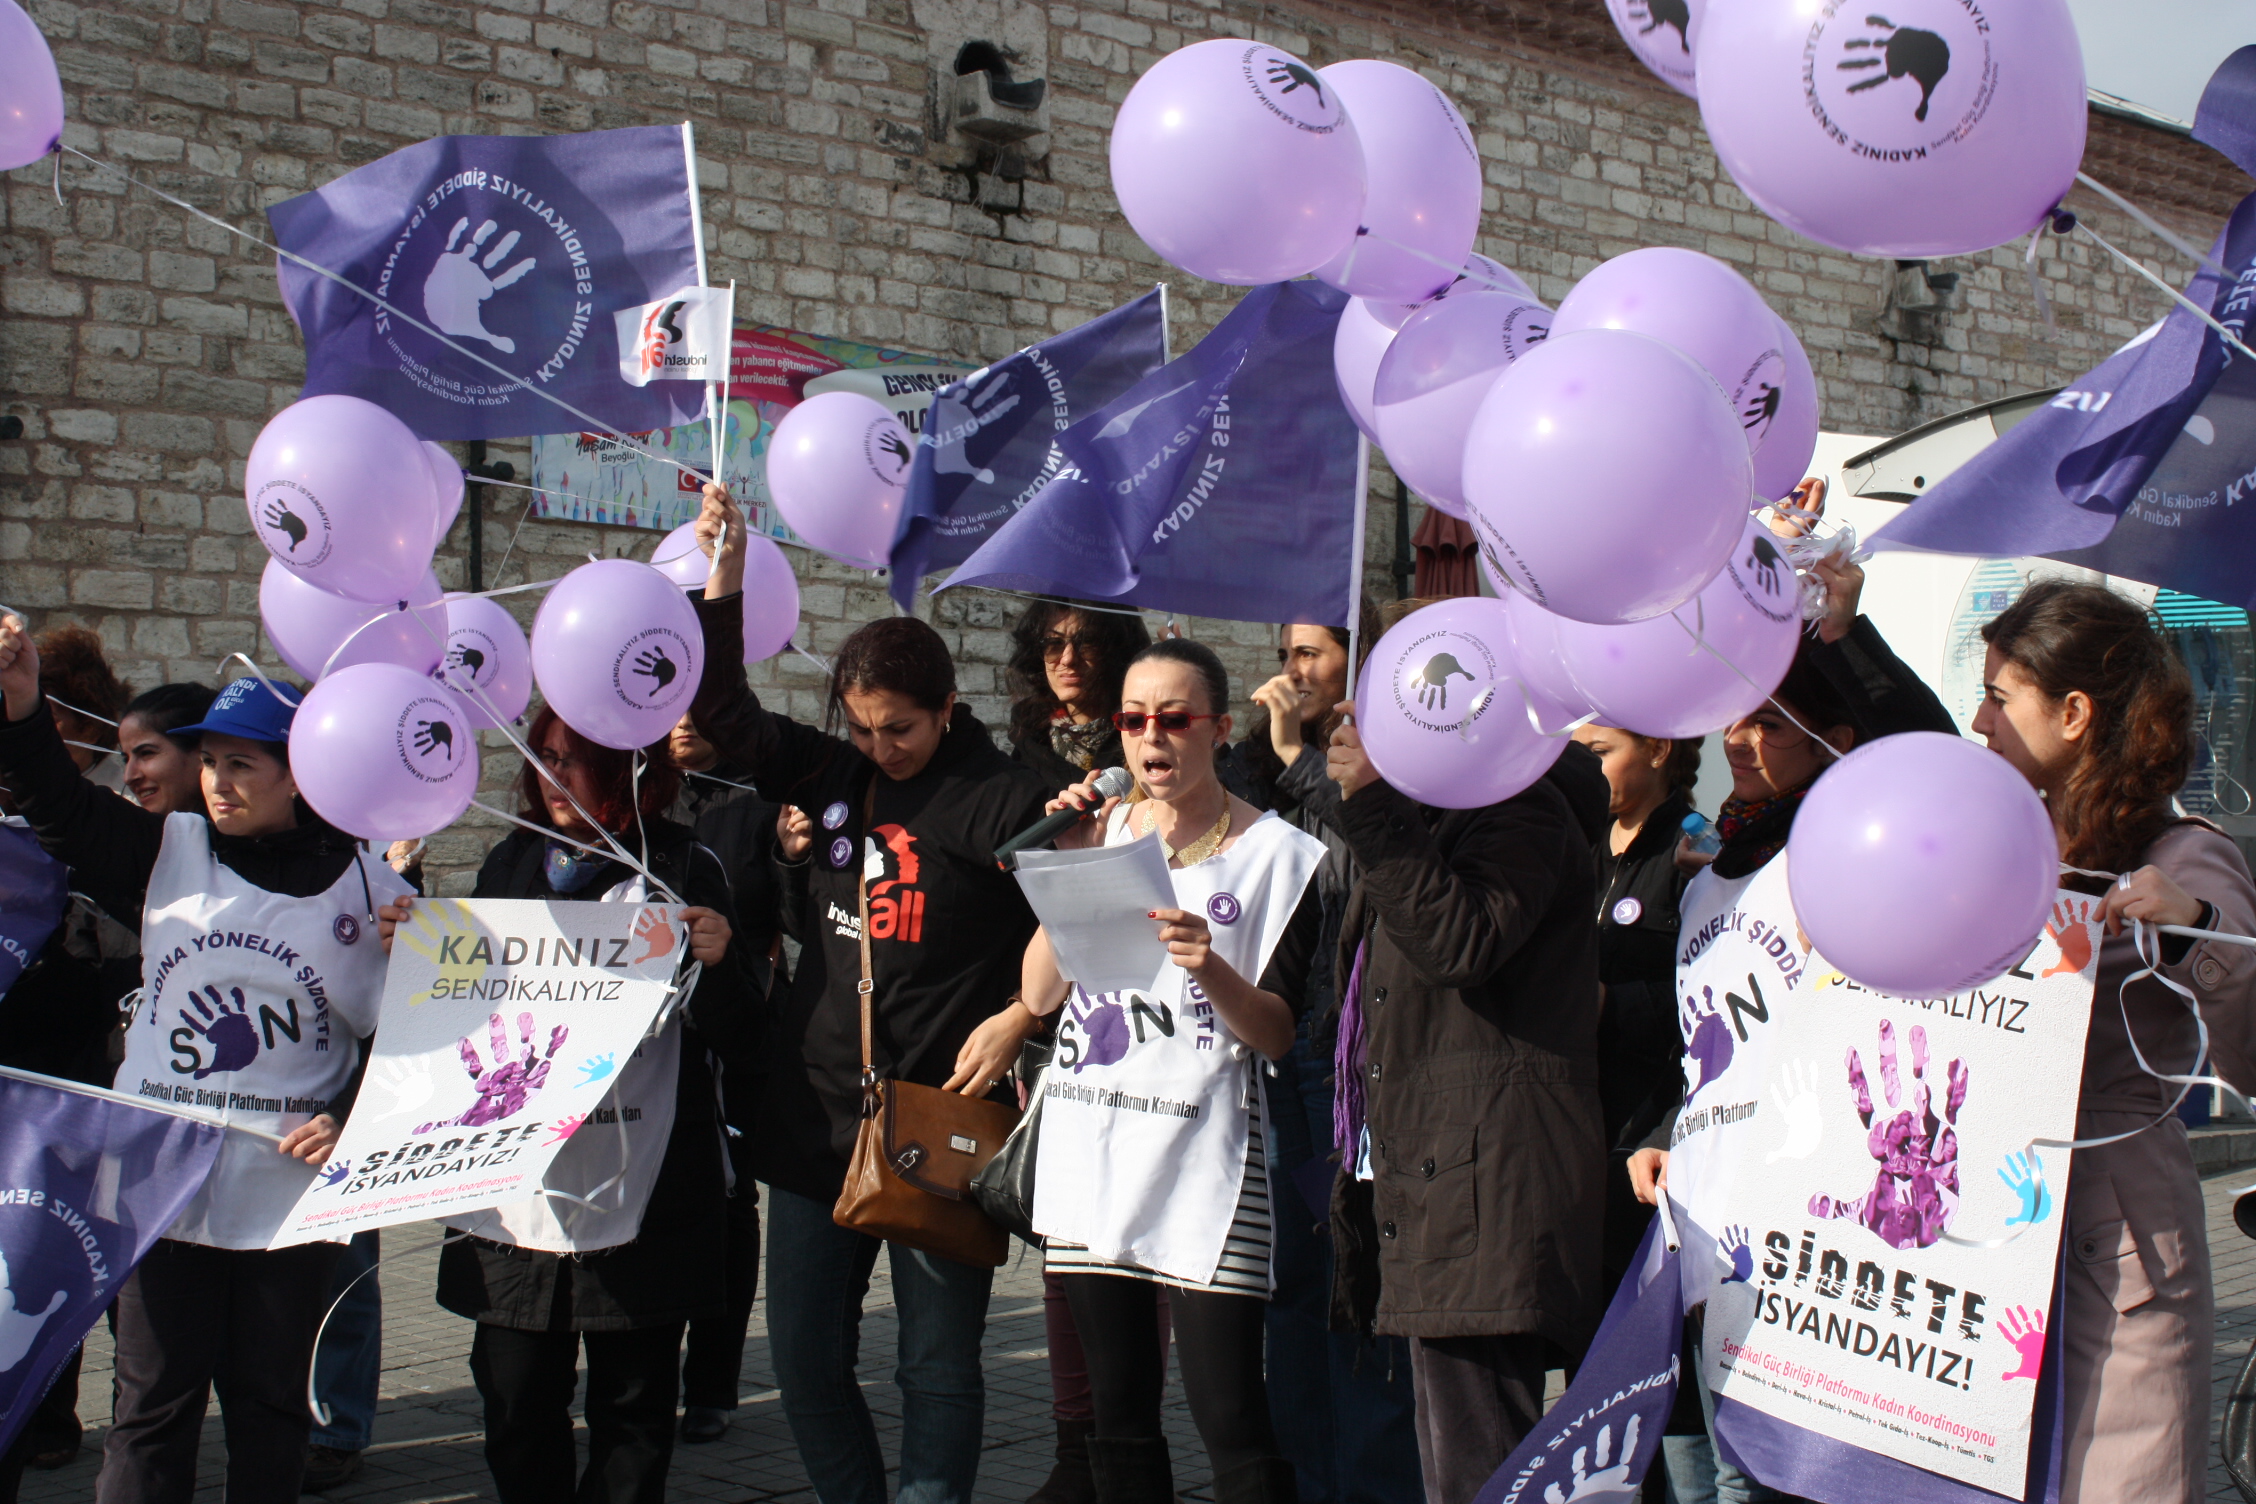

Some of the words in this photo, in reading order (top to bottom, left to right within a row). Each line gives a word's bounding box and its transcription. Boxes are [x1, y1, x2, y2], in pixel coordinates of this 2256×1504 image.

[1851, 139, 1927, 163] KADINIZ
[740, 371, 790, 387] verilecektir.
[742, 355, 776, 369] yabancı
[777, 358, 823, 376] eğitmenler
[601, 451, 635, 464] Beyoğlu
[640, 627, 673, 640] ŞİDDETE
[1399, 630, 1448, 666] İSYANDAYIZ
[612, 635, 640, 688] SENDİKALIYIZ
[673, 630, 692, 673] İSYANDAYIZ
[616, 688, 643, 710] KADINIZ
[1392, 667, 1406, 711] ŞİDDETE
[1472, 687, 1497, 721] ADINIZ
[398, 700, 419, 728] ŞİDDETE
[396, 730, 425, 781] SENDİKALIYIZ
[425, 771, 453, 784] KADINIZ
[835, 925, 859, 939] global
[869, 889, 926, 943] all
[438, 934, 630, 968] KADINIZ
[1747, 919, 1803, 992] ŞİDDE
[150, 946, 188, 1026] KADINA
[192, 929, 301, 968] YÖNELİK
[294, 965, 330, 1052] ŞİDDETE
[430, 974, 625, 1002] SENDİKALIYIZ
[139, 1078, 173, 1101] Sendikal
[174, 1085, 194, 1106] Güç
[195, 1089, 227, 1109] Birliği
[228, 1092, 282, 1113] Platformu
[1062, 1081, 1077, 1103] Güç
[1077, 1084, 1096, 1106] Birliği
[1097, 1087, 1149, 1113] Platformu
[1151, 1096, 1200, 1119] Kadınları
[596, 1105, 642, 1124] Kadları
[1684, 1108, 1710, 1136] Birliği
[357, 1121, 544, 1177] ŞİDDETE
[340, 1147, 522, 1196] İSYANDAYIZ!
[302, 1208, 341, 1223] Sendikal
[340, 1205, 358, 1216] Güç
[357, 1199, 385, 1213] Birliği
[384, 1190, 430, 1208] Platformu
[428, 1186, 456, 1197] Kadın
[456, 1174, 524, 1192] Koordinasyonu
[1760, 1229, 1988, 1344] ŞİDDETE
[1753, 1279, 1974, 1392] İSYANDAYIZ!
[1721, 1337, 1763, 1367] Sendikal
[1763, 1353, 1783, 1378] Güç
[1782, 1360, 1816, 1388] Birliği
[1815, 1372, 1871, 1406] Platformu
[1871, 1392, 1905, 1418] Kadın
[1906, 1403, 1997, 1448] Koordinasyonu
[1983, 1454, 1995, 1464] TGS
